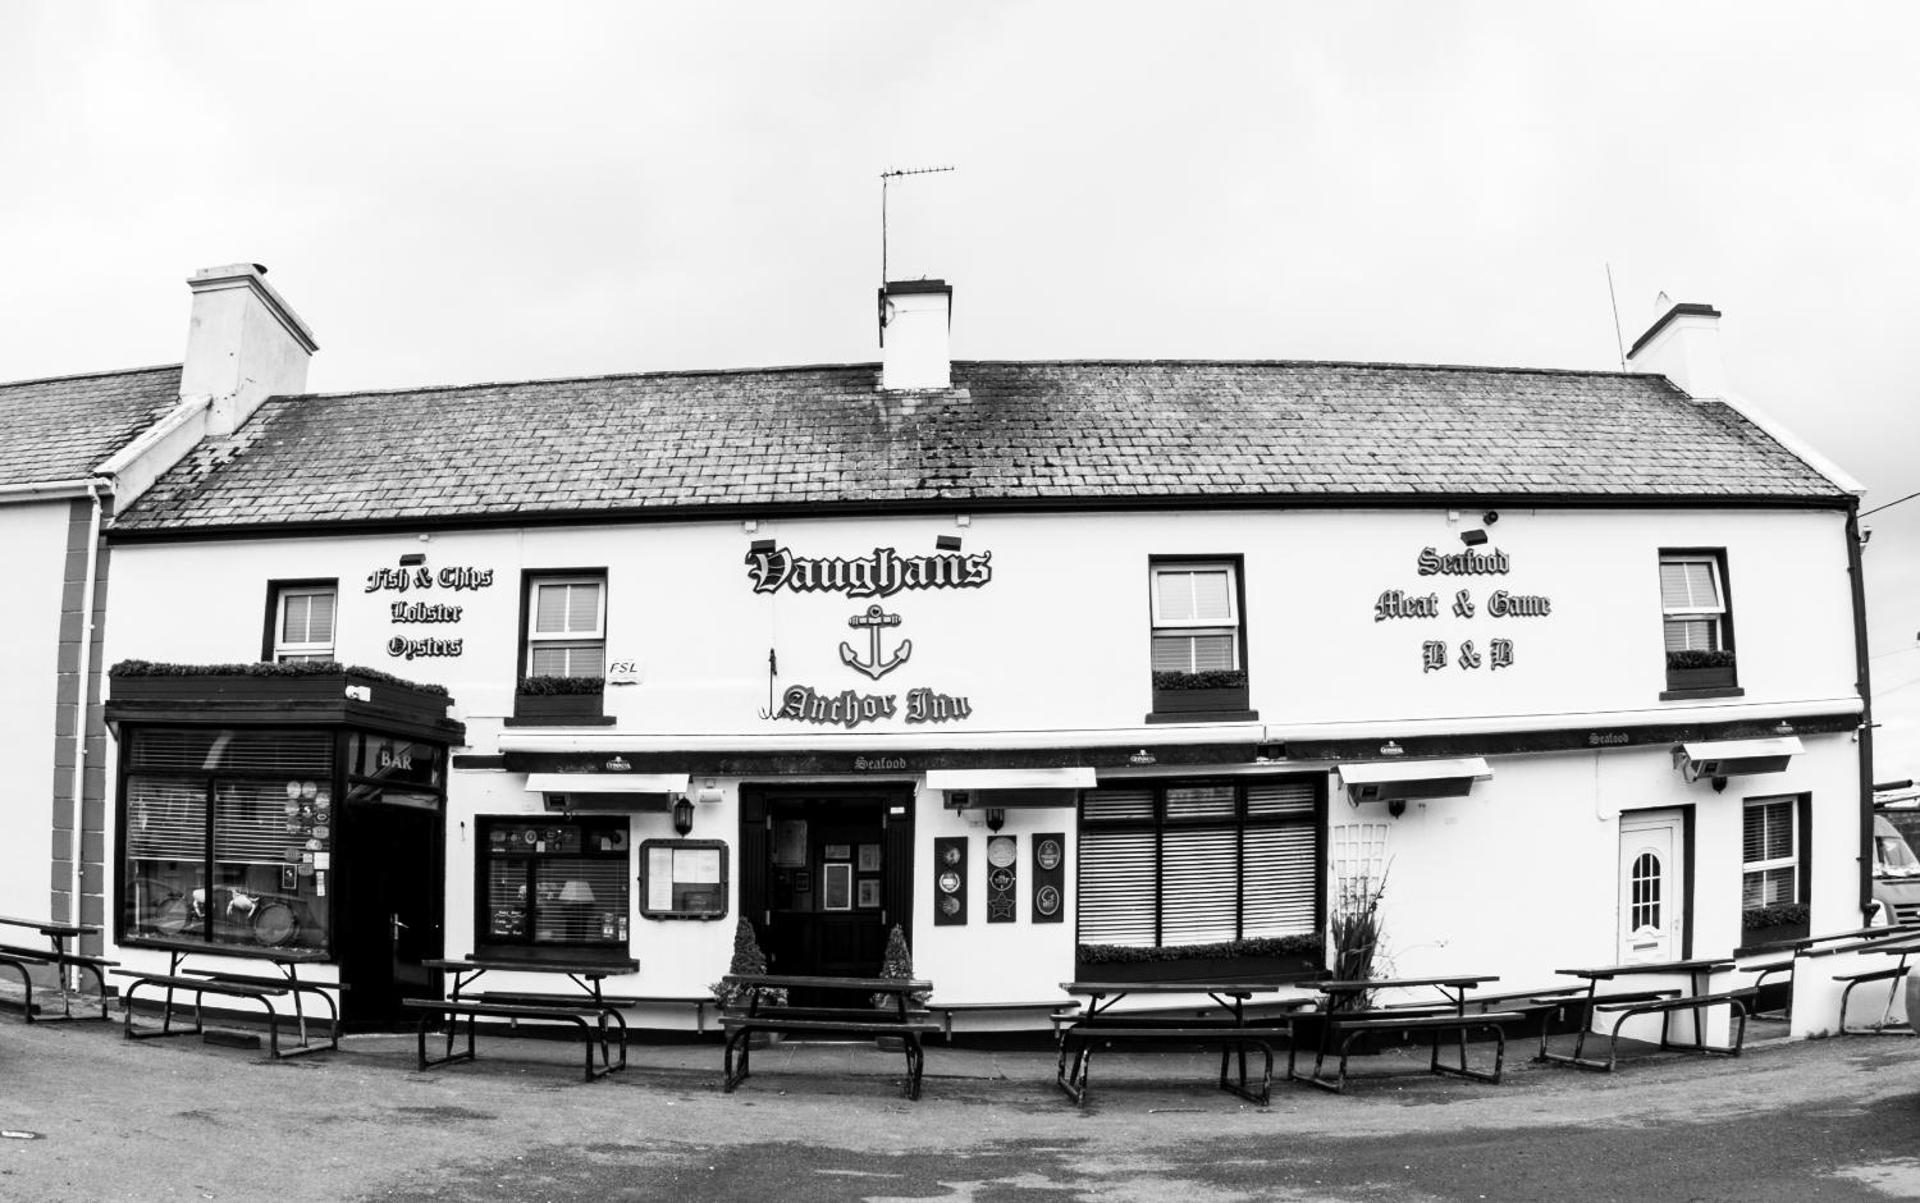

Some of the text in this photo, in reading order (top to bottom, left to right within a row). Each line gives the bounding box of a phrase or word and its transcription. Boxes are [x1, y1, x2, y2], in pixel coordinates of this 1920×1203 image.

[744, 547, 992, 599] Vaughans
[1417, 547, 1510, 576] Seafood
[364, 566, 494, 593] Fish & Chips
[391, 601, 463, 624] Lobster
[1374, 588, 1553, 623] Meat & Game
[387, 635, 463, 661] Oysters
[1422, 637, 1514, 673] B & B
[610, 662, 638, 673] FSL
[779, 684, 973, 729] Anchor Inn
[381, 750, 413, 770] BAR
[854, 756, 907, 770] Seafood
